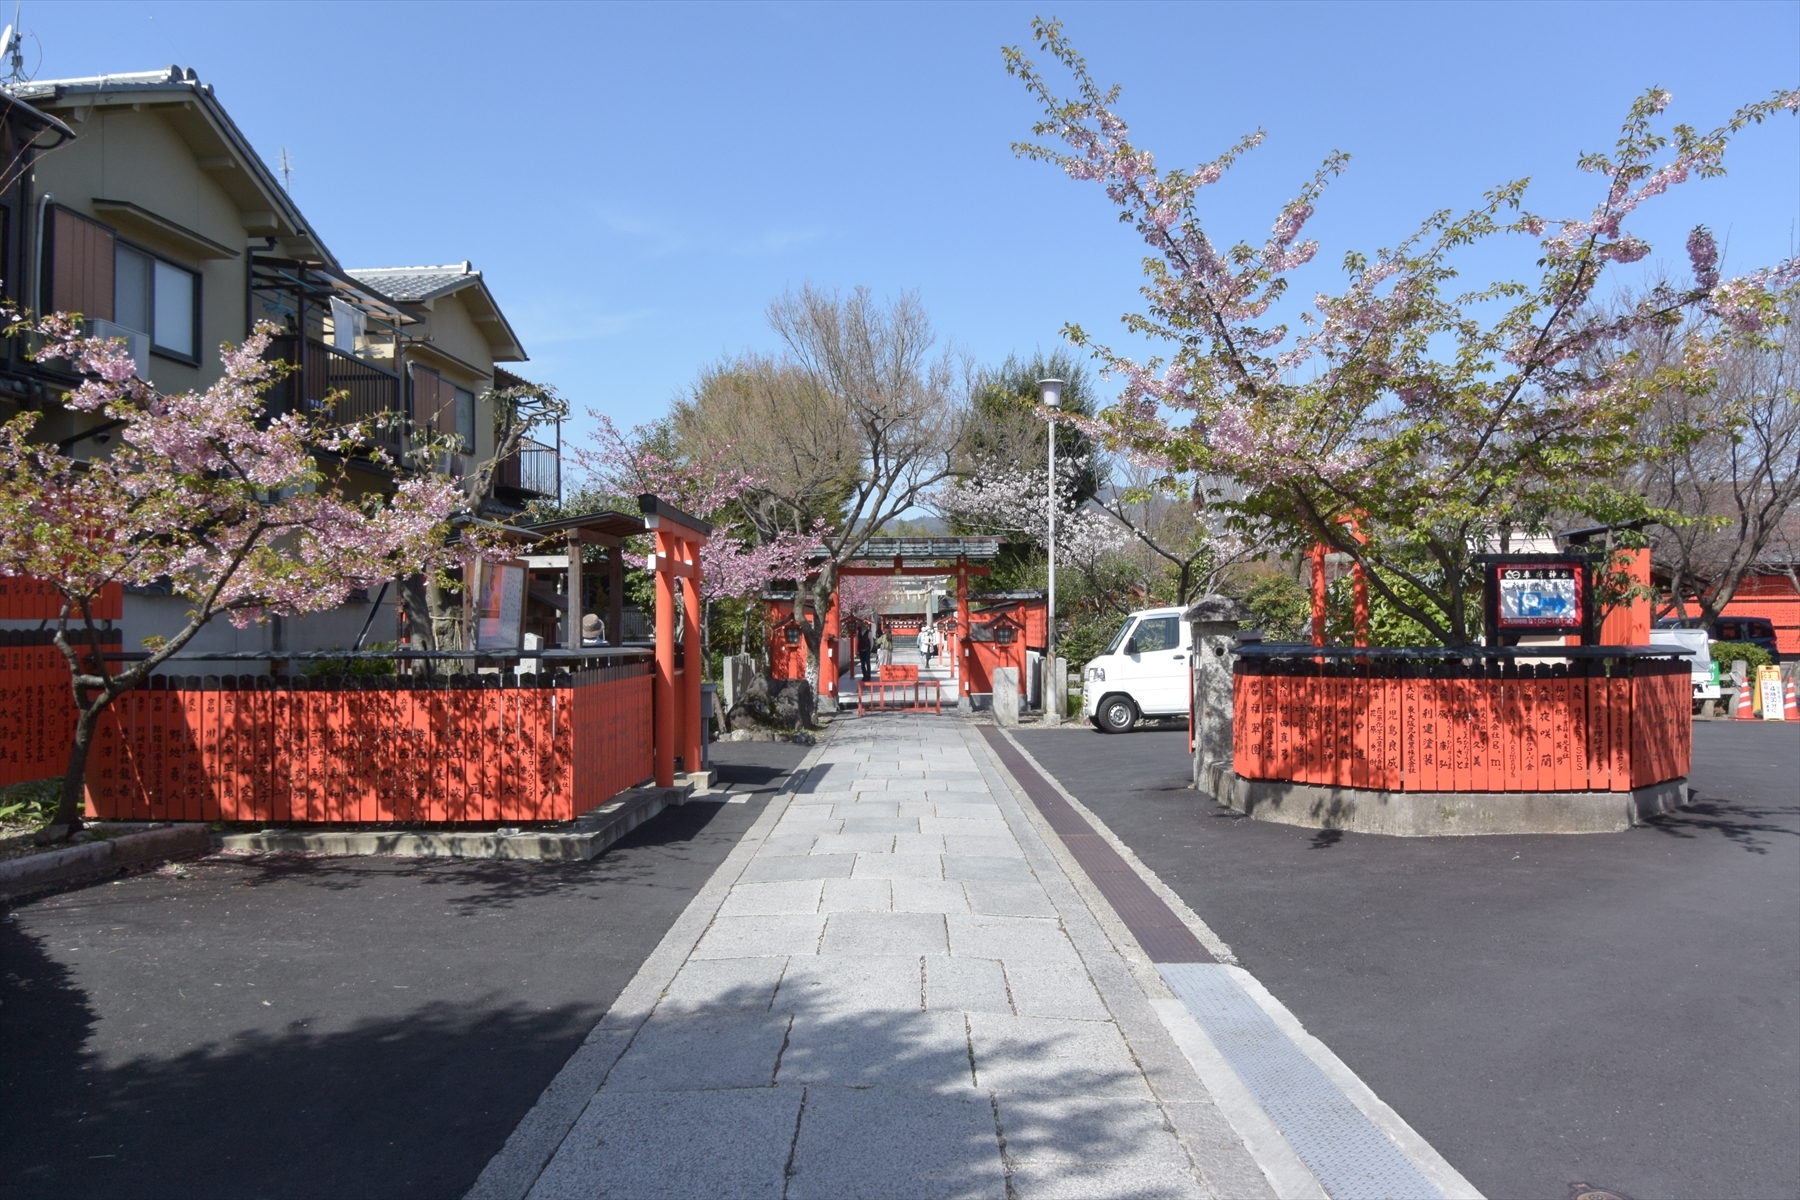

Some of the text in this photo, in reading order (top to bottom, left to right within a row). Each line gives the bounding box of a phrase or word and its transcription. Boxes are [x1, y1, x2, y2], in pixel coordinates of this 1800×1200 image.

[1265, 682, 1274, 698] 大阪
[1279, 681, 1288, 698] 大阪
[1405, 684, 1415, 702] 大阪
[1540, 685, 1551, 702] 大阪
[1555, 685, 1565, 702] 仙台
[1573, 684, 1582, 700] 大阪
[207, 698, 215, 714] 京都
[223, 698, 234, 714] 大阪
[48, 684, 57, 757] VOGUE
[1279, 703, 1289, 761] 村田真弓
[1387, 710, 1398, 769] 児島良成
[223, 727, 235, 800] 岩本正一郎
[554, 727, 564, 796] 山田大介
